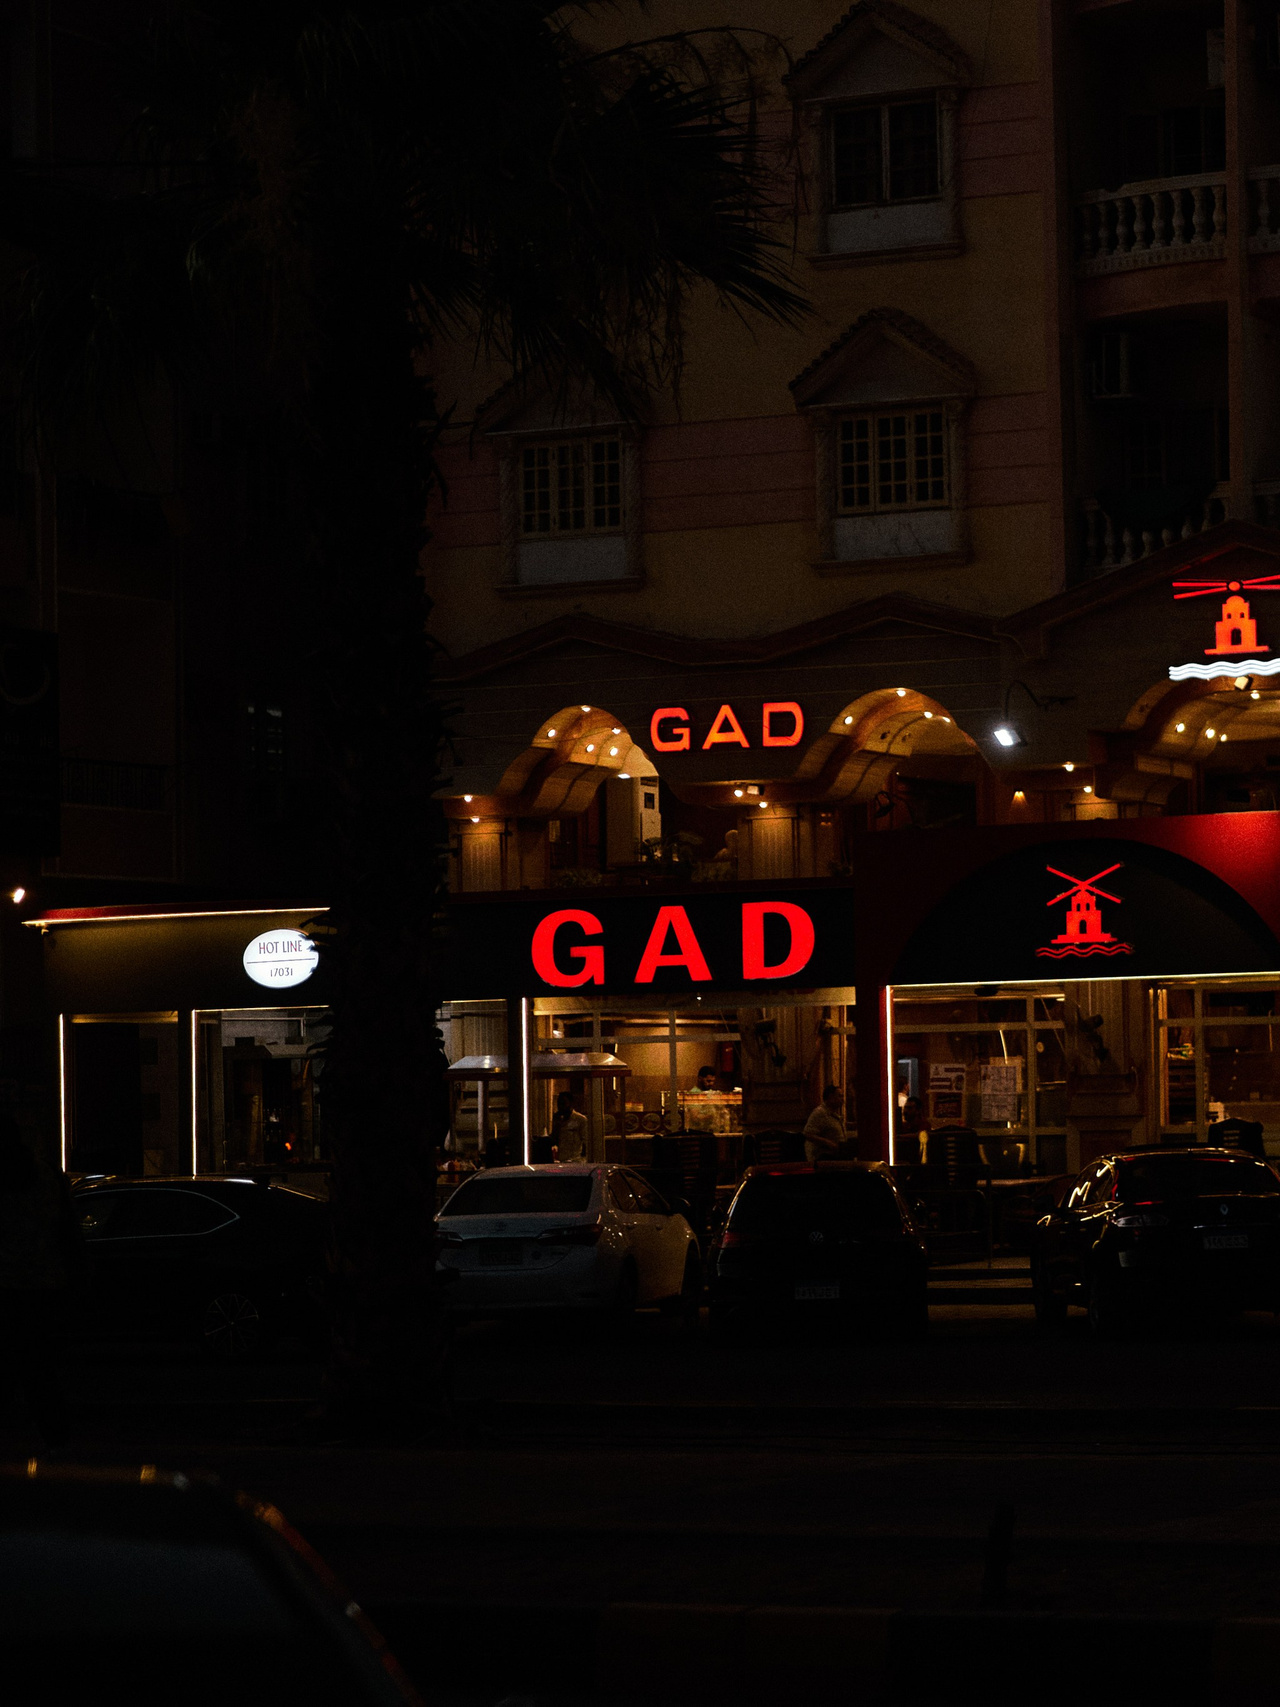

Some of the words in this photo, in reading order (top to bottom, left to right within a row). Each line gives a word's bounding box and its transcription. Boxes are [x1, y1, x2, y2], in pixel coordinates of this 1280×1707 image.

[650, 701, 804, 752] GAD
[258, 941, 279, 954] HOT
[282, 939, 303, 953] LINE
[531, 900, 815, 988] GAD
[269, 967, 294, 977] 17031
